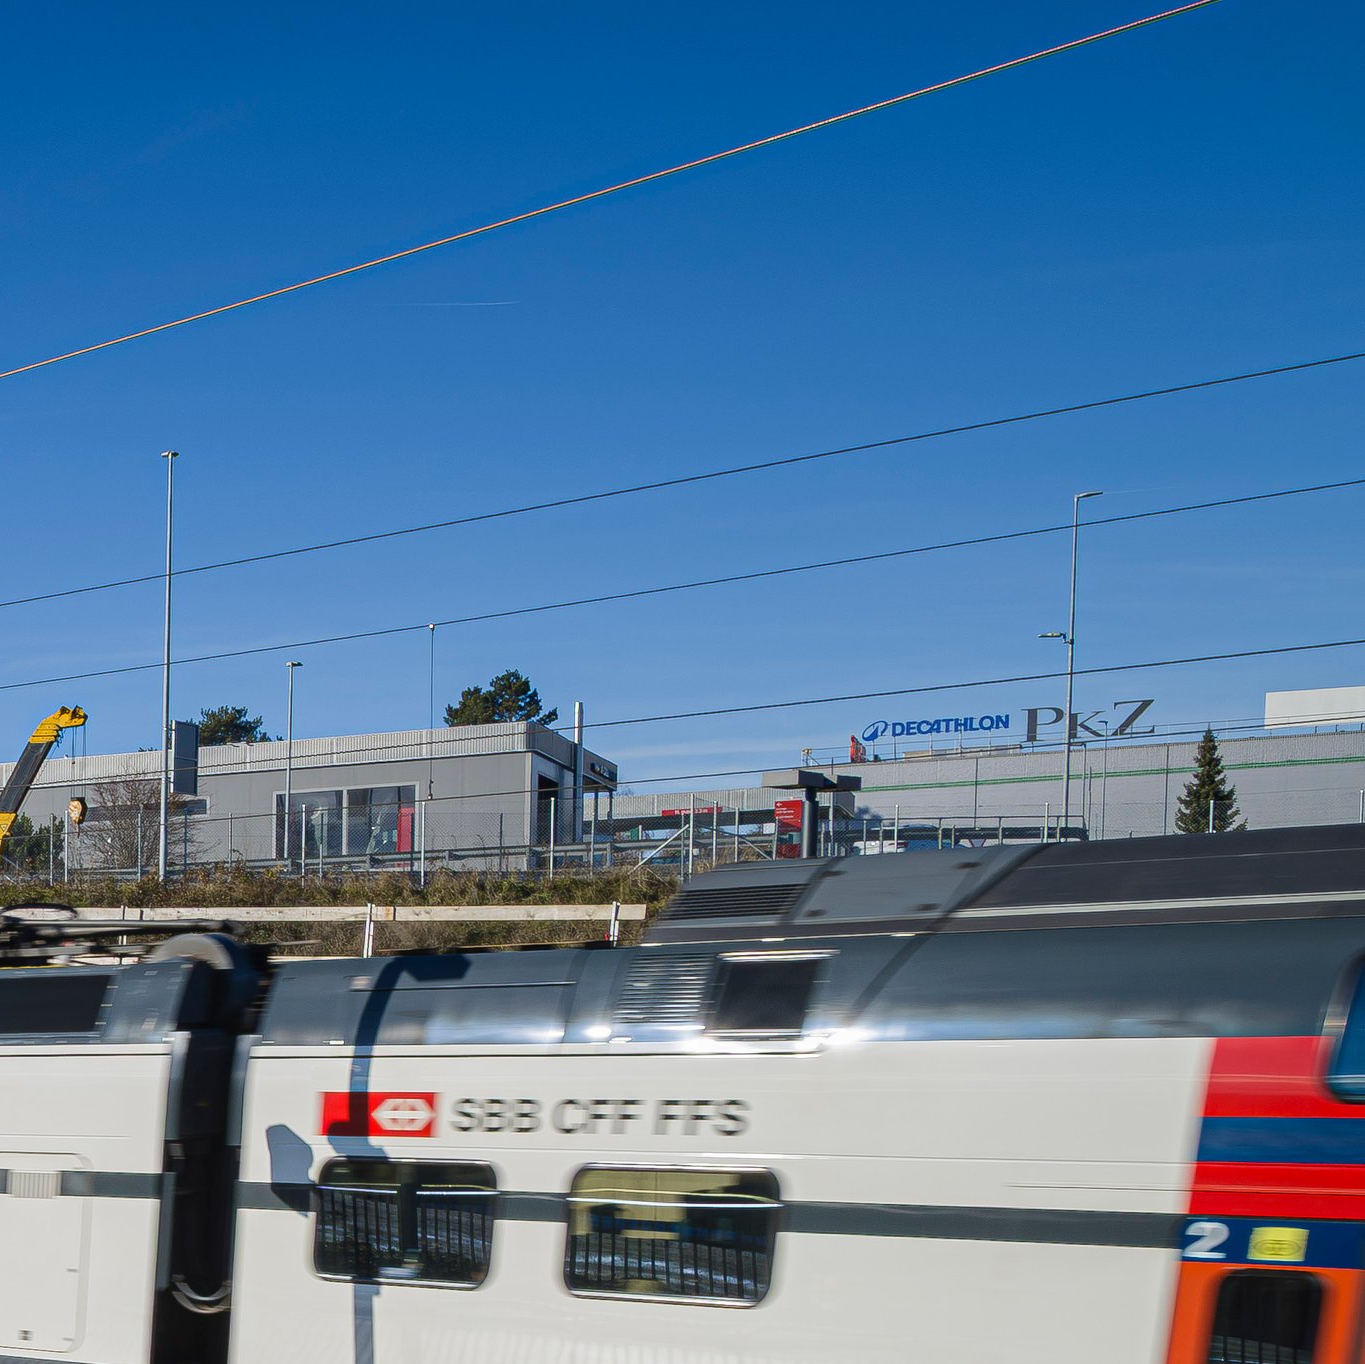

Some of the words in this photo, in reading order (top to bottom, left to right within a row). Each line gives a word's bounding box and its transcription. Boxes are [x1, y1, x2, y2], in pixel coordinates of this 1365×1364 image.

[891, 714, 1010, 737] DECATHLON
[450, 1098, 544, 1134] SBB
[551, 1098, 647, 1135] CFF
[651, 1099, 752, 1137] FFS
[1181, 1221, 1230, 1259] 2
